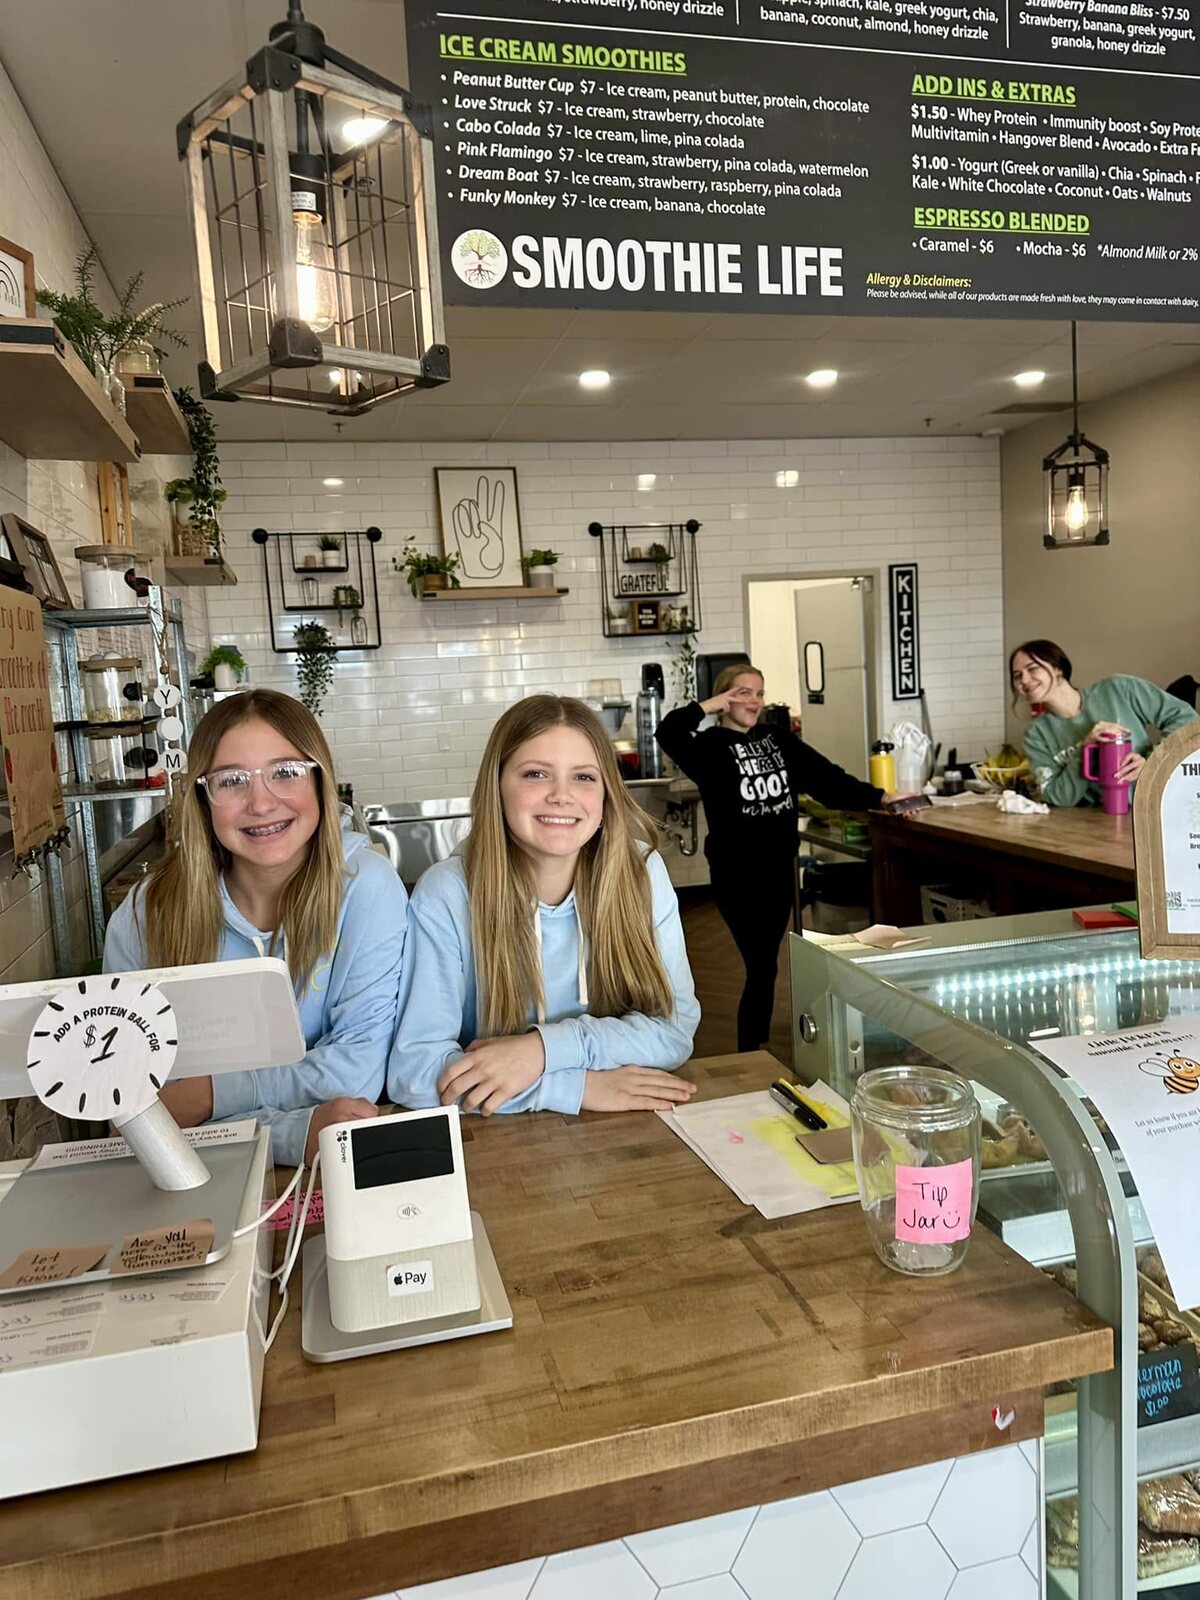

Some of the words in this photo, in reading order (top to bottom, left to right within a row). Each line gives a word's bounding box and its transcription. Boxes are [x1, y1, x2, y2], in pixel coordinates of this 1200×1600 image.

[640, 0, 679, 16] honey
[682, 1, 725, 17] drizzle
[760, 5, 809, 25] banana,
[811, 14, 862, 29] coconut,
[864, 16, 912, 34] almond,
[914, 22, 950, 39] honey
[951, 24, 989, 40] drizzle
[894, 2, 928, 16] greek
[929, 6, 971, 20] yogurt,
[972, 8, 999, 24] chia,
[1087, 0, 1129, 16] Banana
[1130, 3, 1154, 17] Bliss
[1161, 6, 1191, 21] $7.50
[1019, 11, 1082, 32] Strawberry,
[1083, 17, 1126, 35] banana,
[1127, 23, 1157, 38] greek
[1158, 28, 1196, 42] yogurt,
[439, 34, 475, 57] ICE
[479, 37, 558, 63] CREAM
[561, 43, 687, 73] SMOOTHIES
[1051, 35, 1096, 51] granola,
[1097, 37, 1130, 55] honey
[1131, 40, 1167, 56] drizzle
[453, 70, 501, 88] Peanut
[504, 74, 546, 91] Butter
[548, 77, 575, 95] Cup
[579, 79, 596, 95] $7
[606, 81, 626, 97] Ice
[627, 85, 670, 102] cream,
[673, 88, 718, 103] peanut
[719, 89, 761, 107] butter,
[763, 94, 810, 110] protein,
[812, 96, 870, 113] chocolate
[911, 74, 953, 95] ADD
[957, 77, 988, 98] INS
[991, 80, 1005, 100] &
[1008, 81, 1077, 105] EXTRAS
[454, 94, 487, 111] Love
[489, 97, 532, 113] Struck
[537, 99, 554, 115] $7
[564, 101, 584, 117] Ice
[586, 105, 630, 121] cream,
[631, 108, 703, 127] strawberry,
[705, 111, 765, 128] chocolate
[911, 103, 948, 121] $1.50
[956, 107, 992, 126] Whey
[994, 109, 1038, 127] Protein
[1050, 114, 1107, 134] Immunity
[1109, 117, 1142, 134] boost
[1149, 121, 1171, 139] Soy
[911, 124, 990, 144] Multivitamin
[999, 130, 1057, 149] Hangover
[1059, 133, 1093, 150] Blend
[1101, 137, 1152, 154] Avocado
[1159, 141, 1189, 156] Extra
[457, 141, 488, 157] Pink
[490, 143, 553, 163] Flamingo
[558, 146, 575, 162] $7
[585, 149, 604, 164] Ice
[606, 152, 650, 168] cream,
[651, 153, 722, 173] strawberry,
[724, 158, 751, 173] pina
[753, 158, 797, 176] colada,
[798, 162, 869, 178] watermelon
[912, 153, 949, 171] $1.00
[957, 157, 999, 176] Yogurt
[1001, 159, 1041, 177] (Greek
[1042, 165, 1056, 176] or
[1057, 164, 1100, 181] vanilla)
[1108, 166, 1134, 181] Chia
[1142, 168, 1187, 185] Spinach
[460, 187, 501, 207] Funky
[503, 190, 557, 209] Monkey
[561, 191, 578, 208] $7
[588, 194, 607, 209] Ice
[609, 197, 652, 213] cream,
[654, 198, 705, 215] banana,
[707, 200, 766, 217] chocolate
[912, 174, 940, 190] Kale
[948, 176, 985, 192] White
[986, 178, 1046, 196] Chocolate
[1055, 182, 1104, 199] Coconut
[1112, 185, 1139, 200] Oats
[1146, 187, 1192, 203] Walnuts
[914, 207, 1005, 230] ESPRESSO
[1009, 211, 1090, 233] BLENDED
[919, 237, 970, 252] Caramel
[979, 238, 995, 254] $6
[1023, 241, 1063, 257] Mocha
[1071, 242, 1087, 257] $6
[1145, 244, 1168, 260] Milk
[1169, 249, 1181, 261] or
[1181, 247, 1199, 261] 2%
[511, 235, 744, 294] SMOOTHIE
[757, 245, 844, 297] LIFE
[866, 272, 902, 288] Allergy
[903, 274, 912, 286] &
[912, 274, 972, 288] Disclaimers:
[620, 574, 670, 593] GRATEFUL
[898, 575, 914, 690] KITCHEN
[53, 1022, 71, 1043] ADD
[73, 1015, 82, 1025] A
[82, 1006, 128, 1020] PROTEIN
[127, 1012, 150, 1033] BALL
[146, 1032, 161, 1052] FOR
[340, 1142, 348, 1164] clover
[911, 1181, 948, 1208] Tip
[902, 1209, 939, 1230] Jar
[404, 1271, 428, 1287] Pay
[1137, 1359, 1182, 1384] erman
